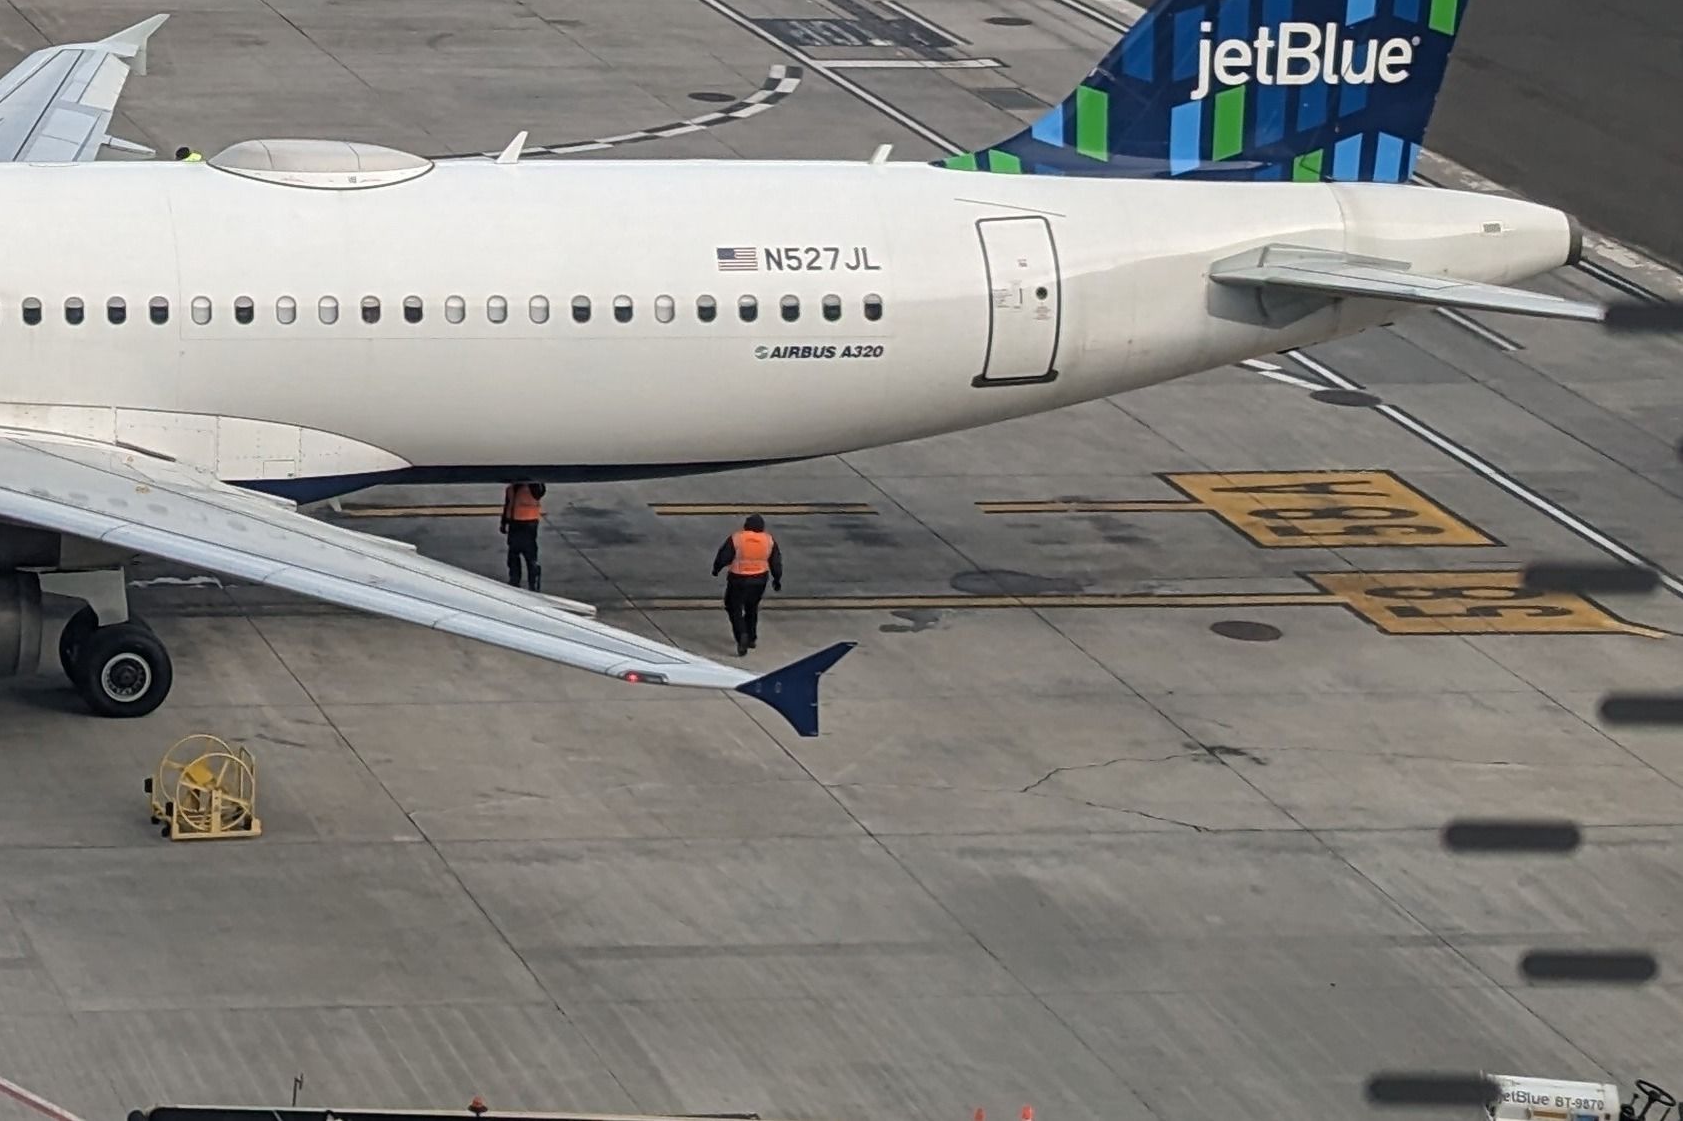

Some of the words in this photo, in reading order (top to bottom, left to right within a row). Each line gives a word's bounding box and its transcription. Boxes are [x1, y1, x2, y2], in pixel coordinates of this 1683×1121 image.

[1190, 21, 1414, 100] jetBlue
[764, 247, 882, 271] N527JL
[770, 346, 836, 359] AIRBUS
[839, 345, 884, 358] A320
[1211, 480, 1445, 538] 58A
[1554, 1095, 1605, 1111] BT-9870
